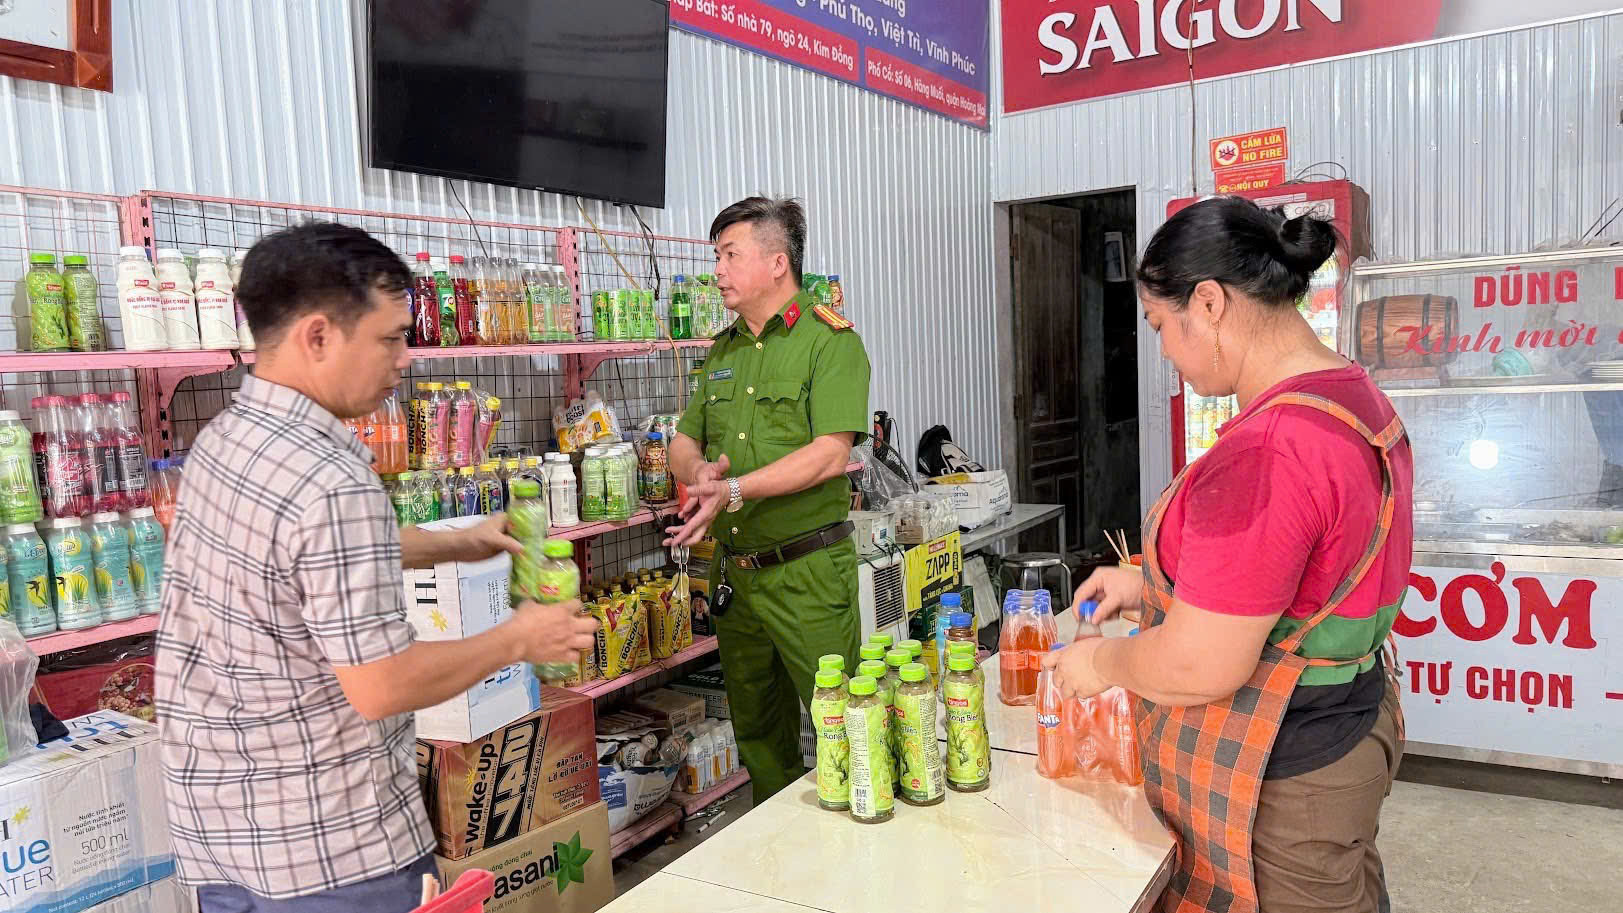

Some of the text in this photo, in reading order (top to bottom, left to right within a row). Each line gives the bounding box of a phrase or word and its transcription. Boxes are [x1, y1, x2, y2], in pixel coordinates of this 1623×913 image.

[721, 4, 735, 24] Số
[737, 13, 757, 32] nhà
[760, 18, 774, 41] 79,
[777, 28, 795, 48] ngõ
[797, 33, 811, 54] 24,
[813, 39, 830, 58] Kim
[832, 46, 853, 71] Đồng
[850, 4, 878, 36] Thọ,
[881, 18, 904, 47] Việt
[907, 30, 923, 56] Trì,
[926, 38, 949, 65] Vĩnh
[952, 51, 976, 76] Phúc
[1037, 0, 1343, 77] SAIGON
[867, 60, 881, 77] Phố
[895, 70, 903, 86] Số
[1241, 132, 1281, 149] CẤM LỬA
[1242, 147, 1283, 162] NO FIRE
[1253, 179, 1269, 189] QUY
[1473, 265, 1578, 308] DŨNG
[925, 552, 950, 580] ZAPP
[1391, 561, 1598, 649] CƠM
[1406, 661, 1573, 713] TỰ CHỌN
[1037, 712, 1061, 725] FANTA
[493, 721, 535, 840] 247
[3, 839, 50, 873] ue
[81, 835, 106, 855] 500
[483, 844, 560, 905] asani
